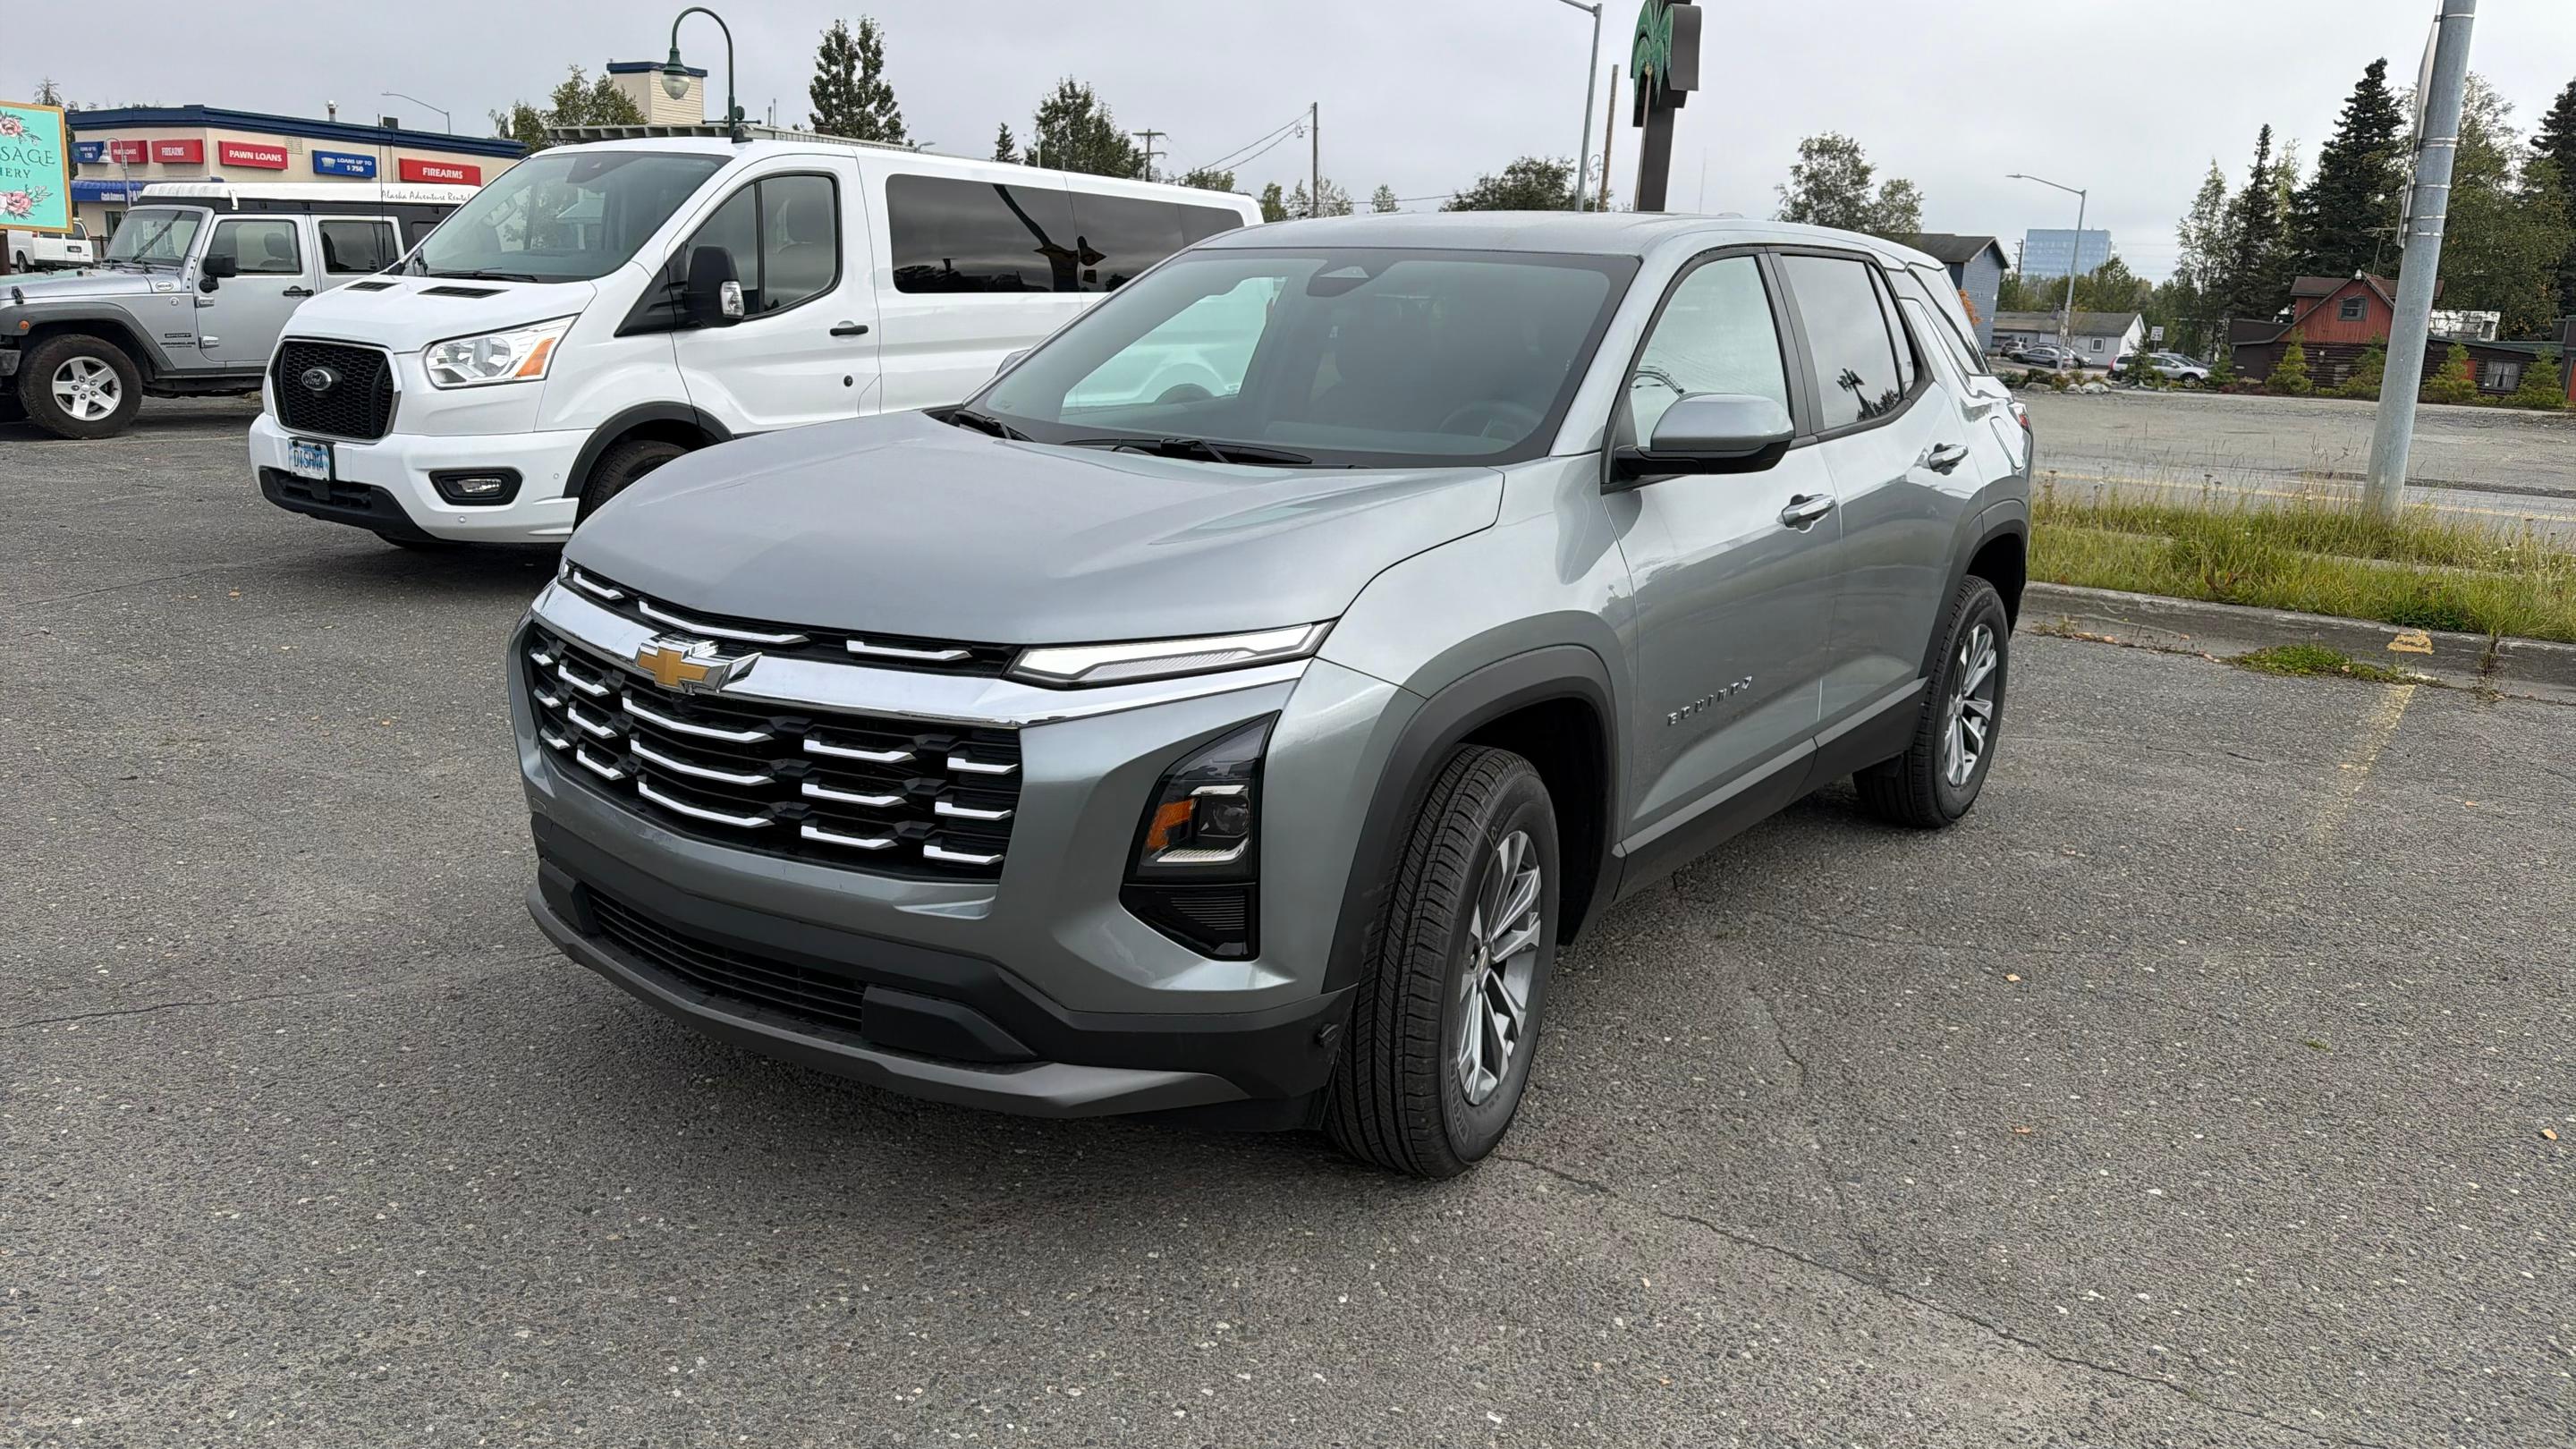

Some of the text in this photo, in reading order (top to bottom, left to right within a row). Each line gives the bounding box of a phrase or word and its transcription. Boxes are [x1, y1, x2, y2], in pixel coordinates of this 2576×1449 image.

[161, 147, 184, 157] FIREARMS
[229, 149, 283, 163] PAWN LOANS
[422, 166, 463, 180] FIREARMS
[382, 190, 407, 199] Alaska
[410, 191, 445, 201] Adventure
[1667, 675, 1753, 726] EQUINOX
